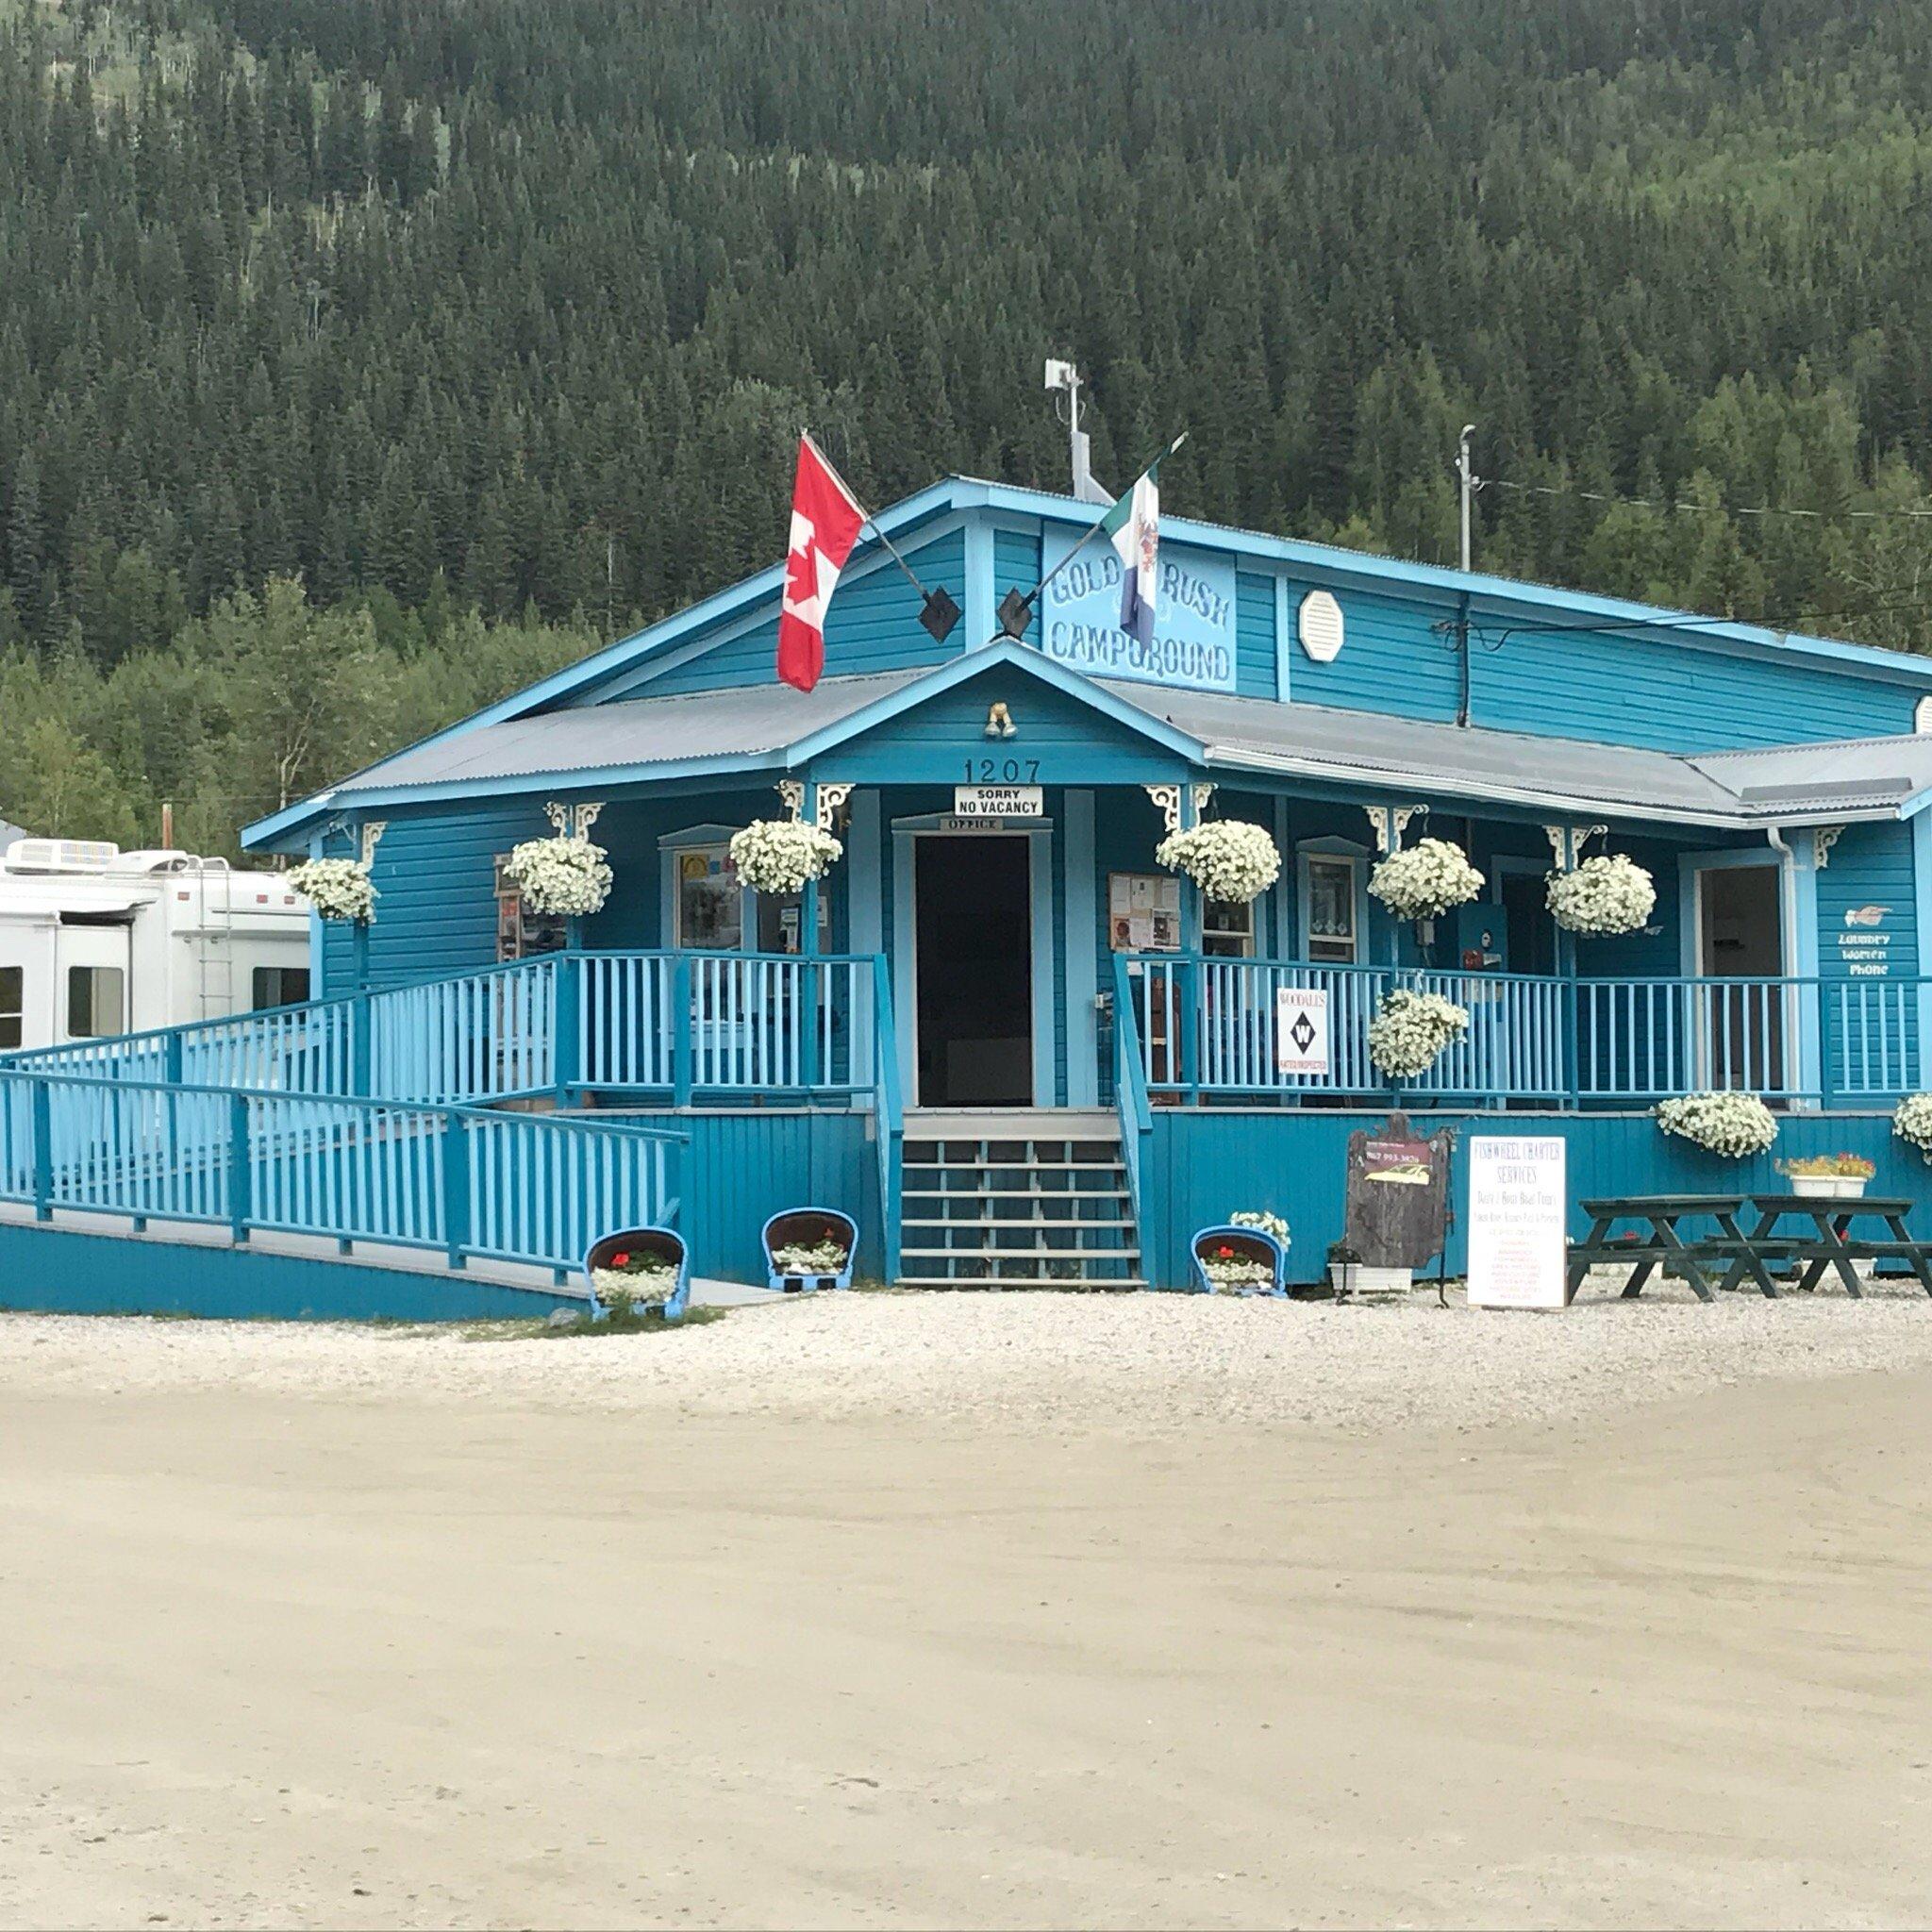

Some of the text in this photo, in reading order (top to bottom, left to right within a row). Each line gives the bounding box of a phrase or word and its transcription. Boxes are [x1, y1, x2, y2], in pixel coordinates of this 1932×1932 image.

[1050, 556, 1230, 628] GOLD RUSH
[964, 758, 1040, 784] 1207
[977, 790, 1020, 799] SORRY
[959, 802, 1038, 813] NO VACANCY
[948, 819, 997, 829] OFFICE
[1295, 1024, 1311, 1043] W
[1497, 1165, 1538, 1184] SERVICES
